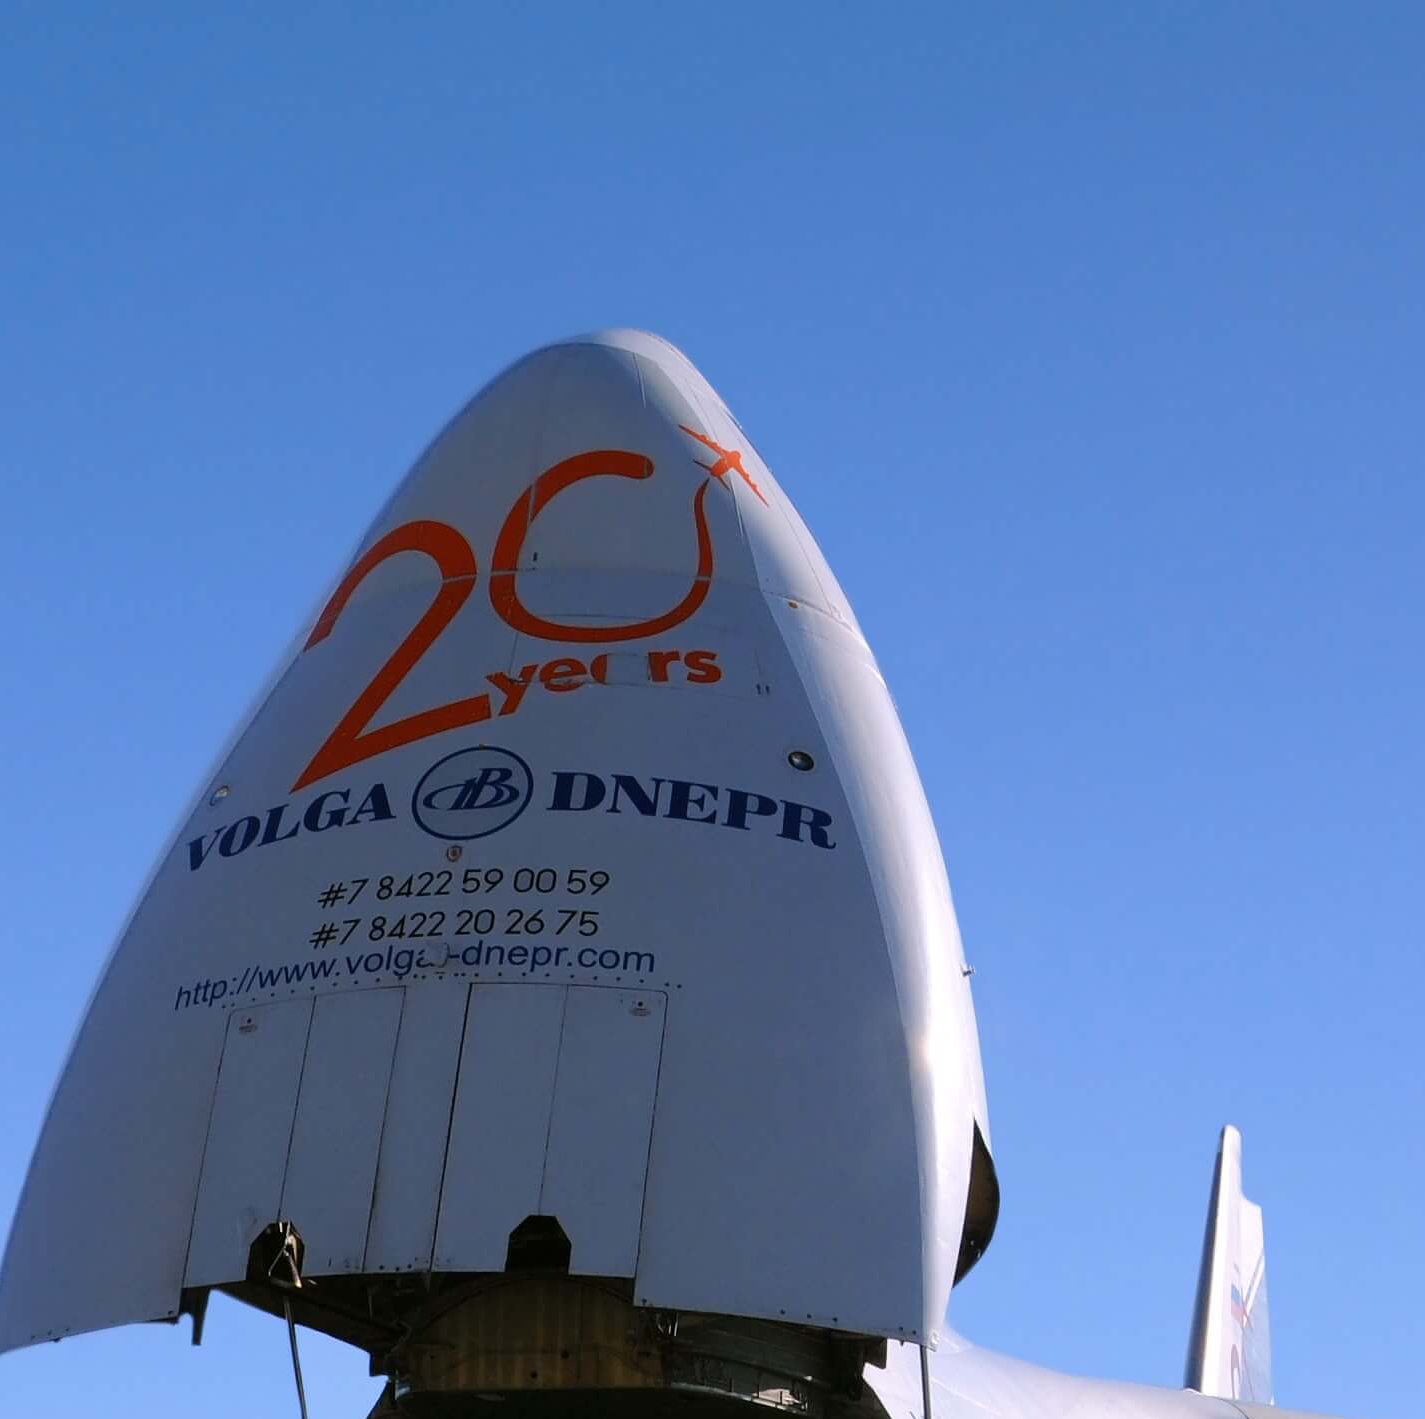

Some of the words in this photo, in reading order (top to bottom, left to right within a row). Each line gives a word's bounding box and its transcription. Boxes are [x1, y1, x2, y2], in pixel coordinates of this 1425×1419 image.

[289, 450, 714, 794] 20
[185, 783, 397, 872] VOLGA
[546, 771, 837, 850] DNEPR
[317, 878, 370, 909] #7
[376, 870, 453, 900] 8422
[461, 868, 504, 894] 59
[513, 868, 557, 893] 00
[567, 870, 610, 895] 59
[309, 918, 362, 949] #7
[368, 911, 446, 941] 8422
[454, 909, 496, 935] 20
[504, 908, 545, 935] 26
[555, 909, 600, 937] 75
